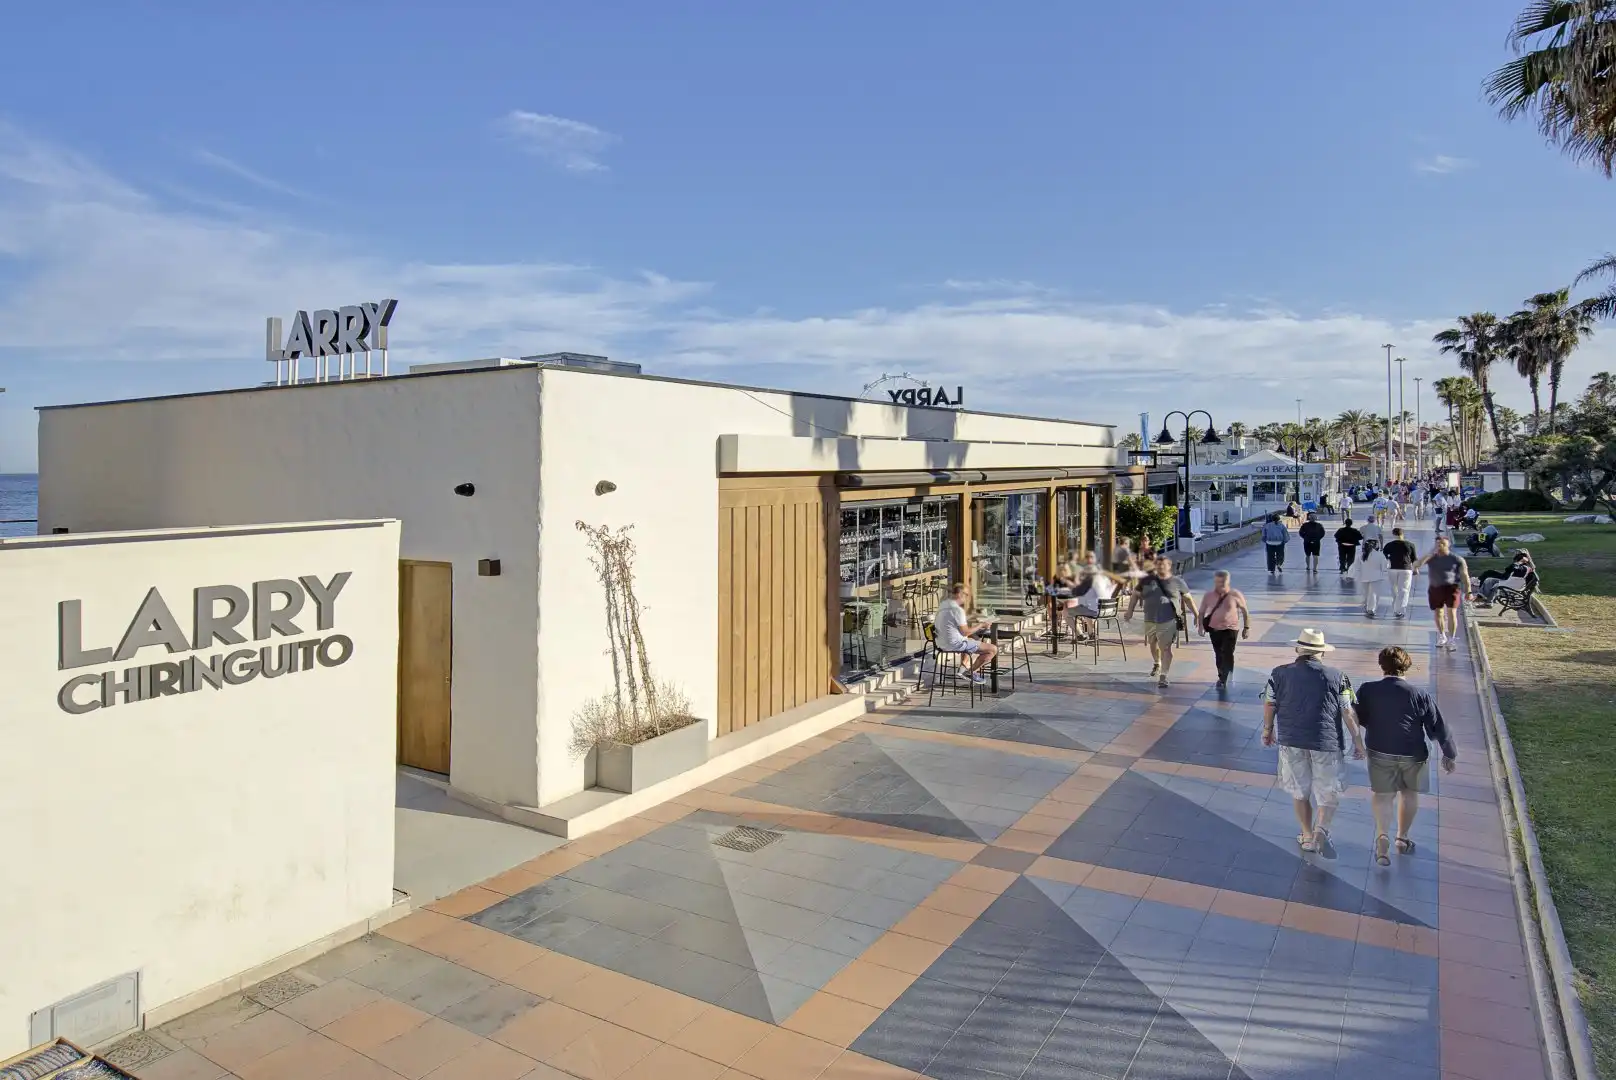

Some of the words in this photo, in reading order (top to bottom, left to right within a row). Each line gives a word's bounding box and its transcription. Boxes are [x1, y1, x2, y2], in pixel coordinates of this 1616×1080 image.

[267, 299, 398, 361] LARRY
[1255, 465, 1270, 473] OH
[58, 571, 353, 671] LARRY
[57, 634, 353, 714] CHIRINGUITO
